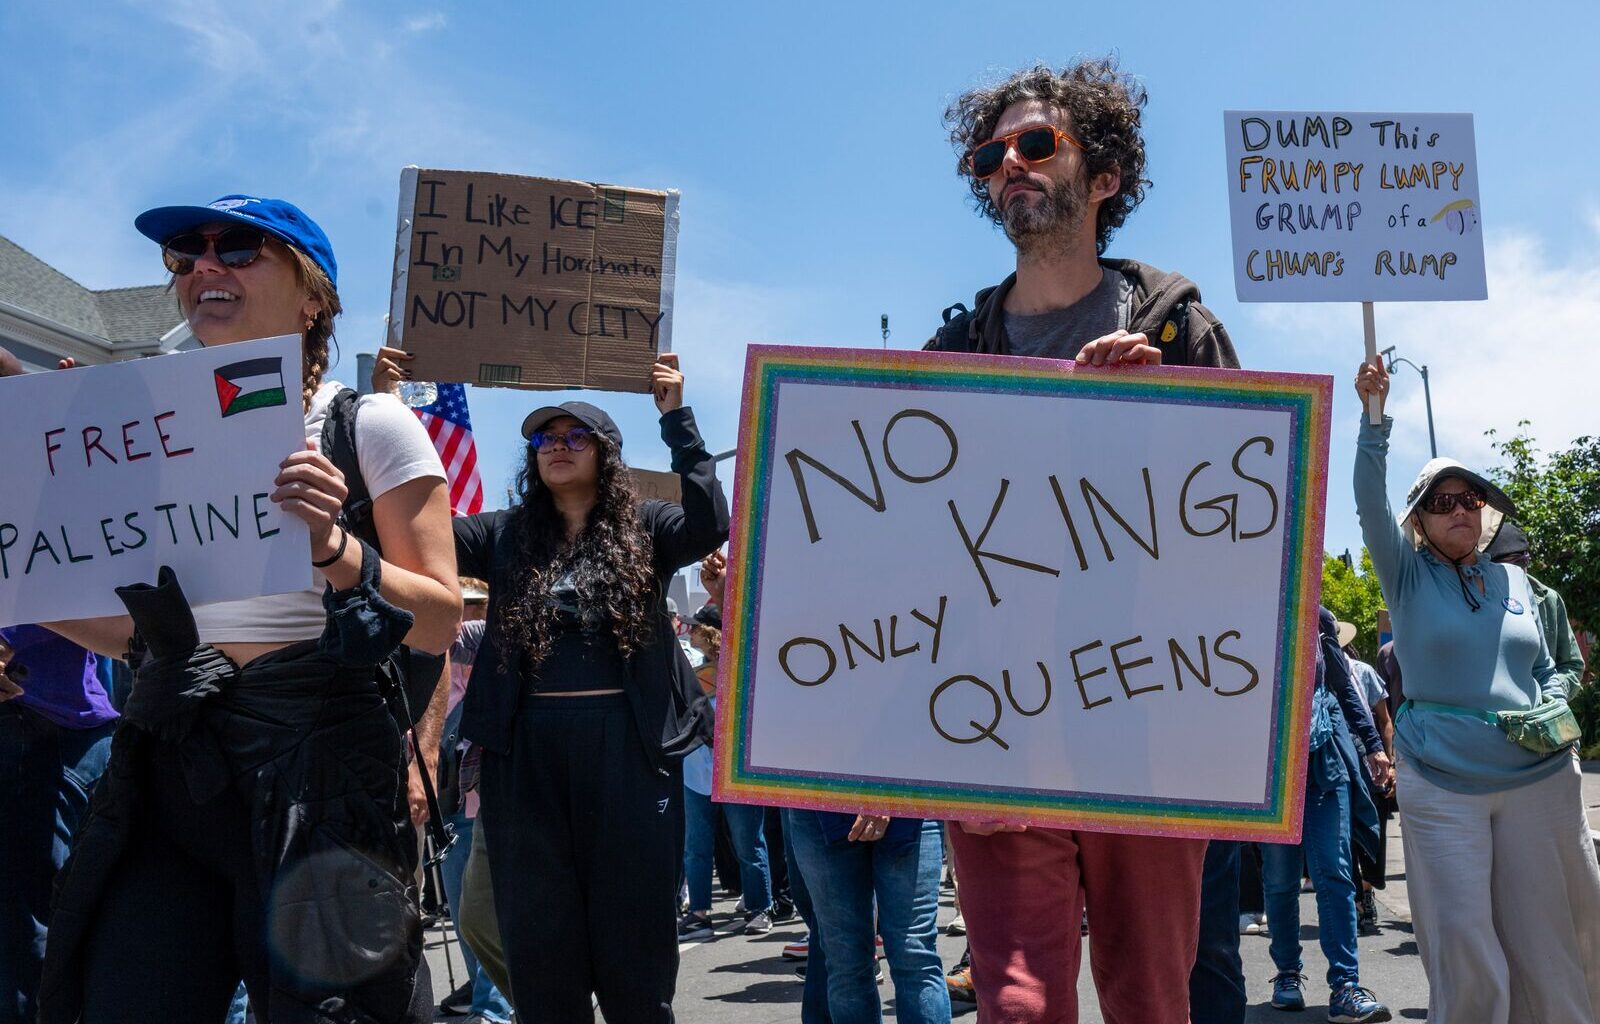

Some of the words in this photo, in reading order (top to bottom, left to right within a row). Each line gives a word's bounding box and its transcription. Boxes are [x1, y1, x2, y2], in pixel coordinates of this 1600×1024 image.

[1241, 116, 1353, 151] DUMP
[1370, 121, 1440, 150] This
[418, 180, 447, 218] I
[465, 183, 531, 227] Like
[550, 195, 600, 229] ICE
[1240, 156, 1364, 194] FRUMPY
[1380, 161, 1464, 191] LUMPY
[1255, 201, 1362, 235] GRUMP
[1388, 203, 1410, 228] of
[1417, 217, 1428, 228] a
[413, 231, 463, 267] In
[478, 234, 529, 277] My
[542, 242, 657, 278] Horchata
[1374, 250, 1457, 281] RUMP
[411, 290, 487, 329] NOT
[502, 294, 557, 331] MY
[568, 301, 665, 349] CITY
[44, 410, 195, 476] FREE
[785, 409, 959, 543] NO
[0, 492, 281, 580] PALESTINE
[948, 436, 1279, 607] KINGS
[778, 596, 947, 686] ONLY
[929, 630, 1259, 750] QUEENS
